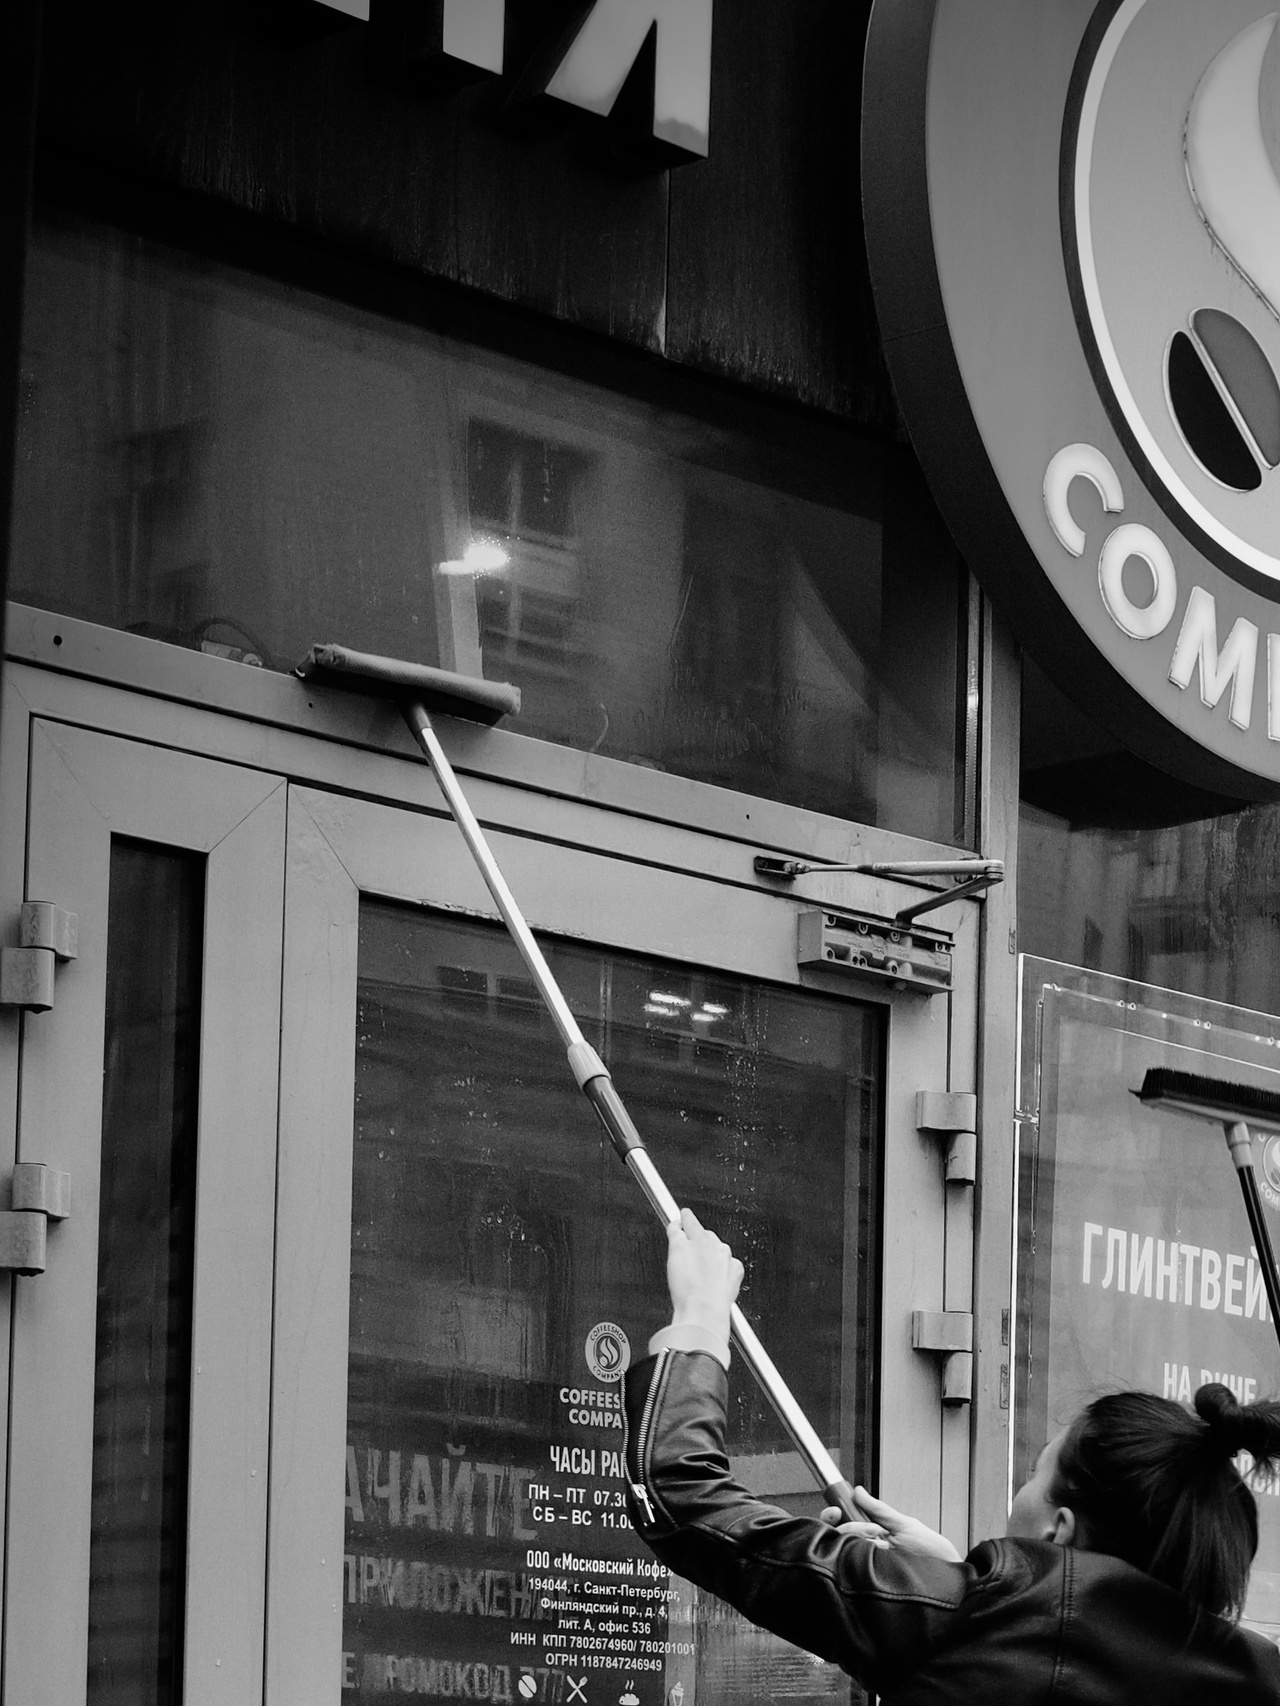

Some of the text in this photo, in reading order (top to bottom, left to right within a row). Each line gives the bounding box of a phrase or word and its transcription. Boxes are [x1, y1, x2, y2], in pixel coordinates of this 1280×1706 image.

[1163, 1362, 1191, 1403] НА
[560, 1388, 621, 1409] COFFEES
[569, 1408, 623, 1429] COMPA
[550, 1445, 595, 1476] ЧАСЫ
[528, 1484, 549, 1500] ПН
[567, 1488, 587, 1504] ПТ
[533, 1506, 555, 1523] СБ
[572, 1509, 592, 1526] ВС
[527, 1550, 550, 1568] ООО
[554, 1552, 633, 1576] «Московский
[529, 1577, 680, 1602] 194044, г. Санкт-Петербург,
[541, 1597, 668, 1620] Финляндский пр., д. 4,
[558, 1619, 580, 1630] лит.
[598, 1620, 630, 1635] офис
[632, 1622, 651, 1634] 536
[511, 1632, 536, 1646] ИНН
[543, 1634, 567, 1647] КПП
[640, 1640, 695, 1656] 780201001
[546, 1653, 663, 1671] ОГРН 1187847246949
